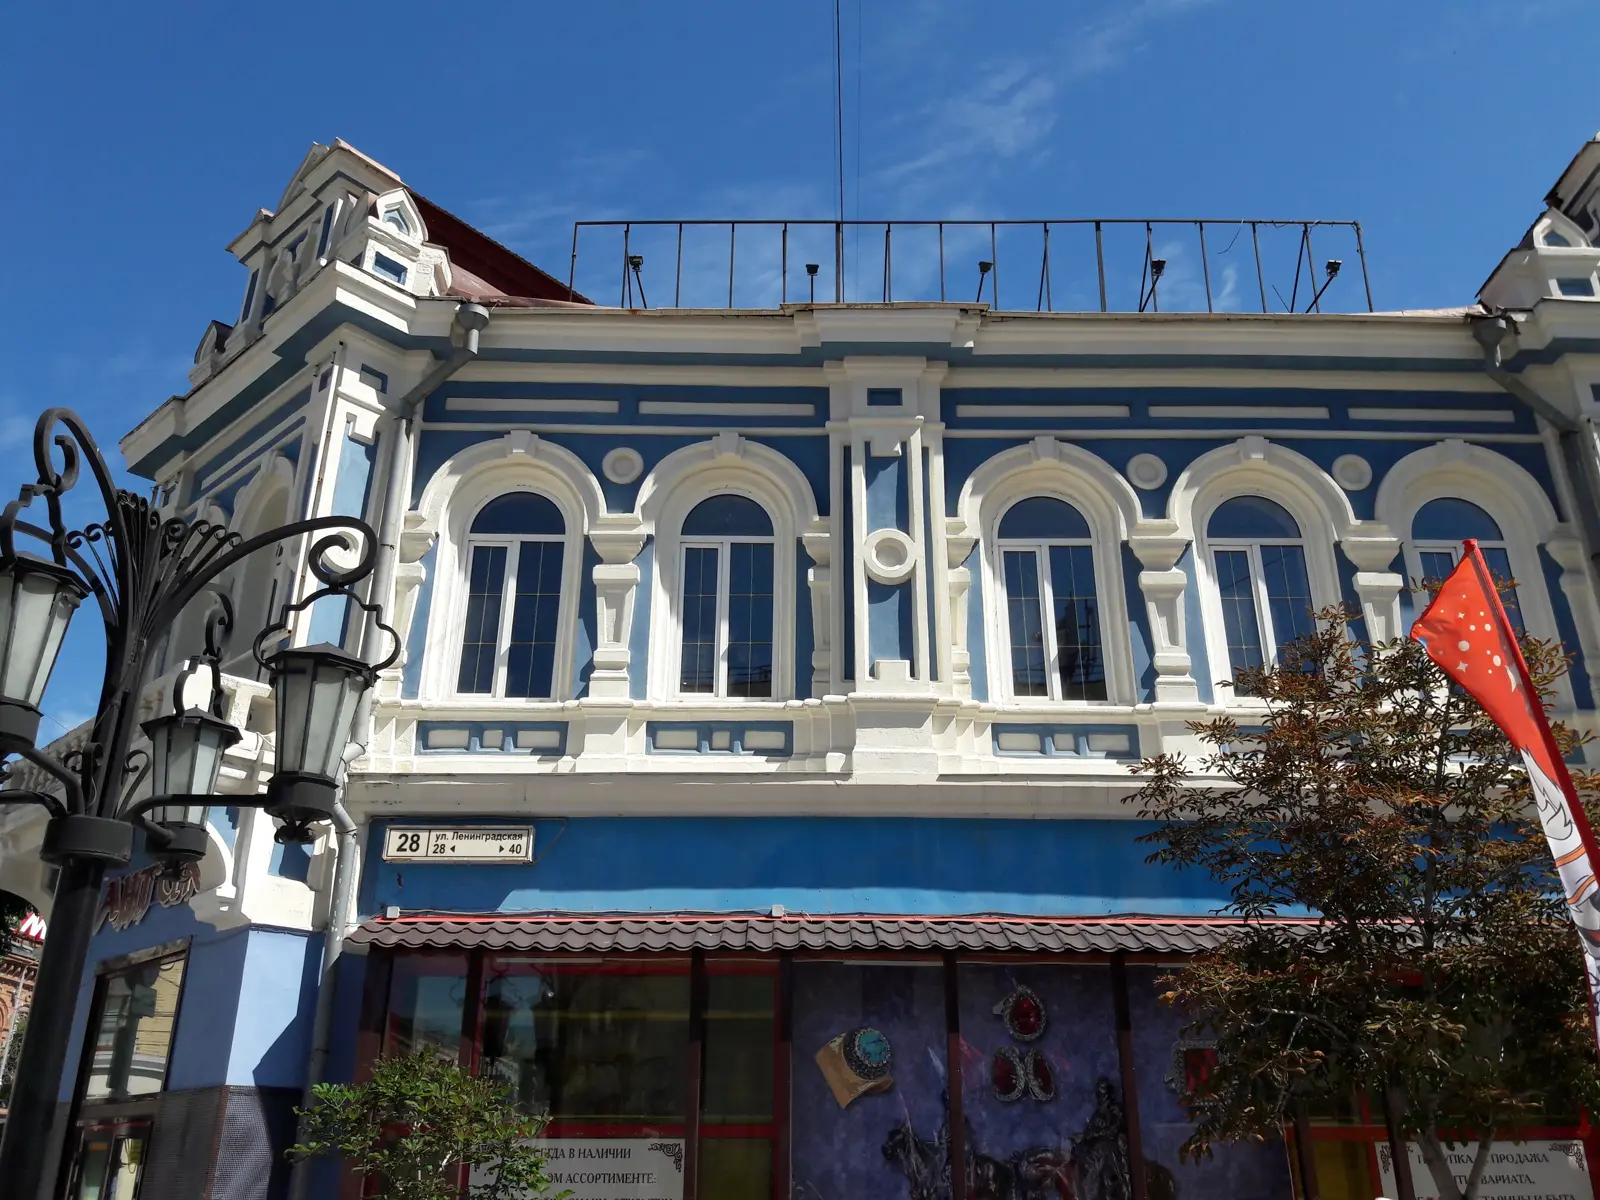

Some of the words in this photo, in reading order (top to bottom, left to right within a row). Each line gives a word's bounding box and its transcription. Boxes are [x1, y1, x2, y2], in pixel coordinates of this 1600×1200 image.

[396, 833, 420, 852] 28
[435, 833, 449, 842] ул.
[452, 832, 523, 842] Ленинградская
[432, 844, 446, 854] 28
[508, 844, 522, 854] 40
[569, 1148, 575, 1159] В
[578, 1148, 632, 1159] НАЛИЧИИ
[1491, 1153, 1550, 1164] ПРОДАЖА
[565, 1173, 657, 1184] АССОРТИМЕНТЕ:
